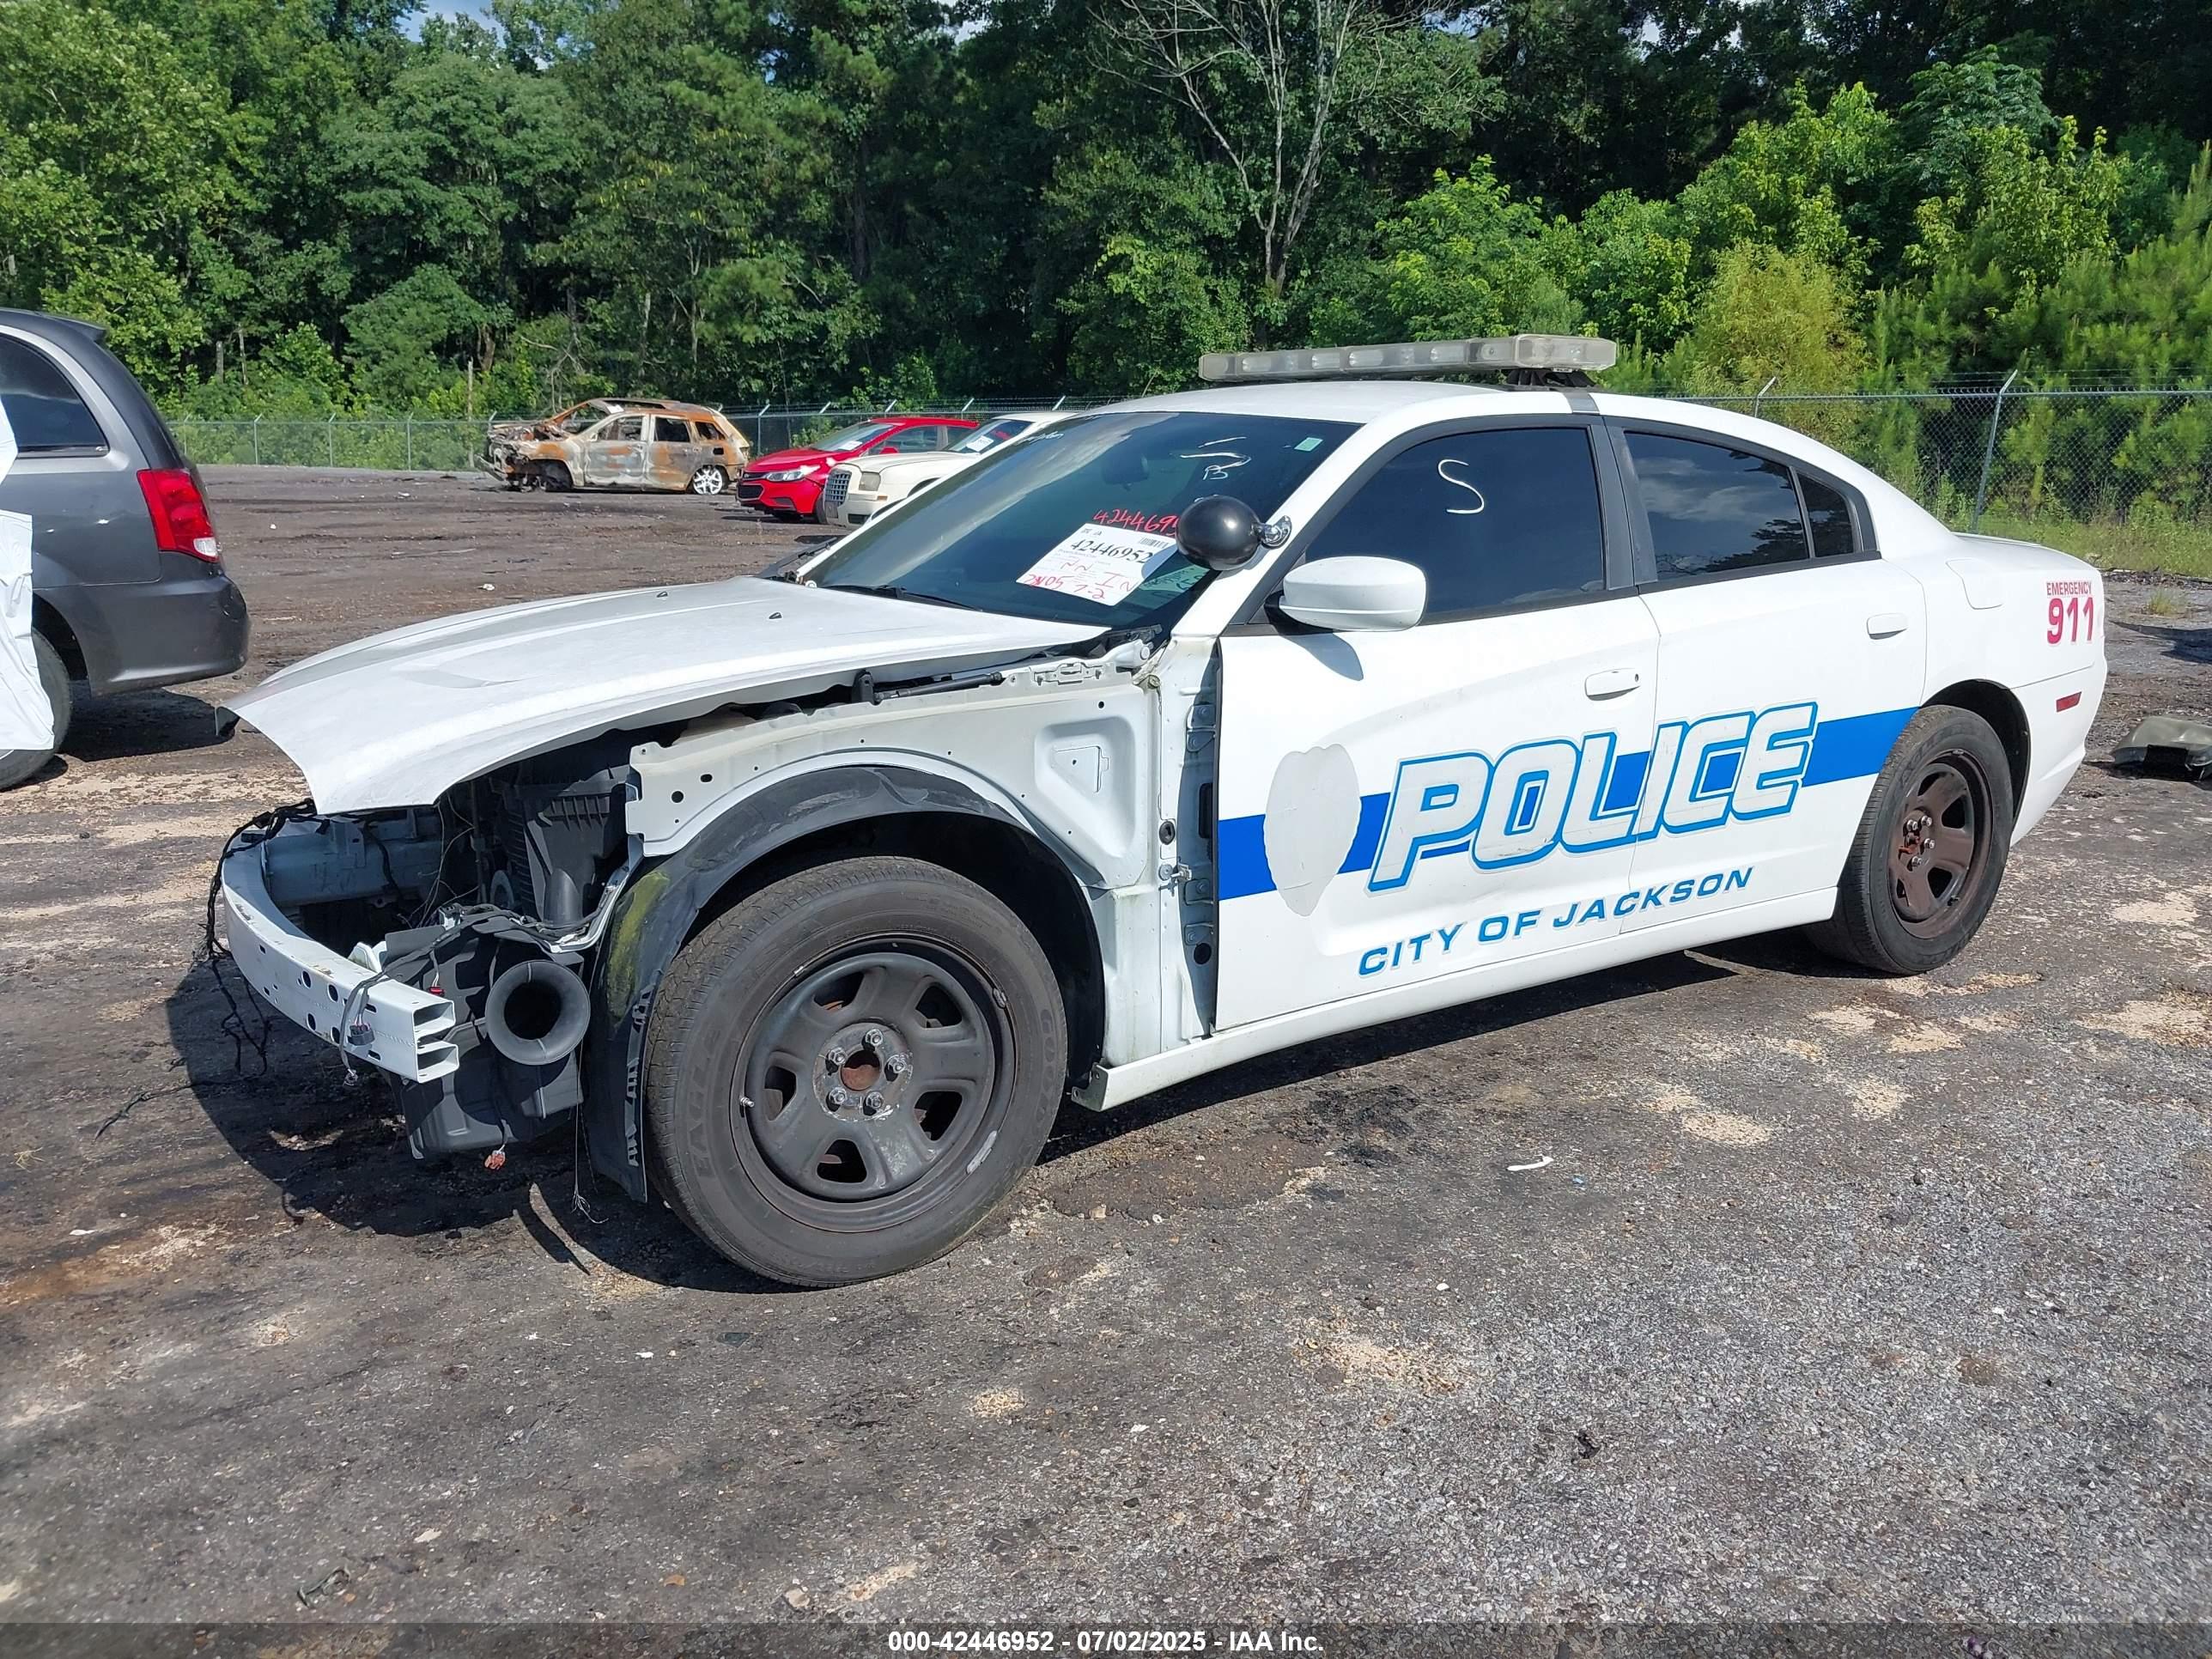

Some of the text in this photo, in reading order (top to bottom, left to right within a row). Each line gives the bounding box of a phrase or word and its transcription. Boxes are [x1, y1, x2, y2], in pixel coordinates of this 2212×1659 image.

[1437, 459, 1485, 514] S
[1071, 539, 1153, 564] 42446952
[2046, 581, 2092, 595] EMERGENCY
[2046, 597, 2094, 644] 911
[1368, 702, 1819, 891] POLICE
[1358, 867, 1753, 975] CITY OF JACKSON
